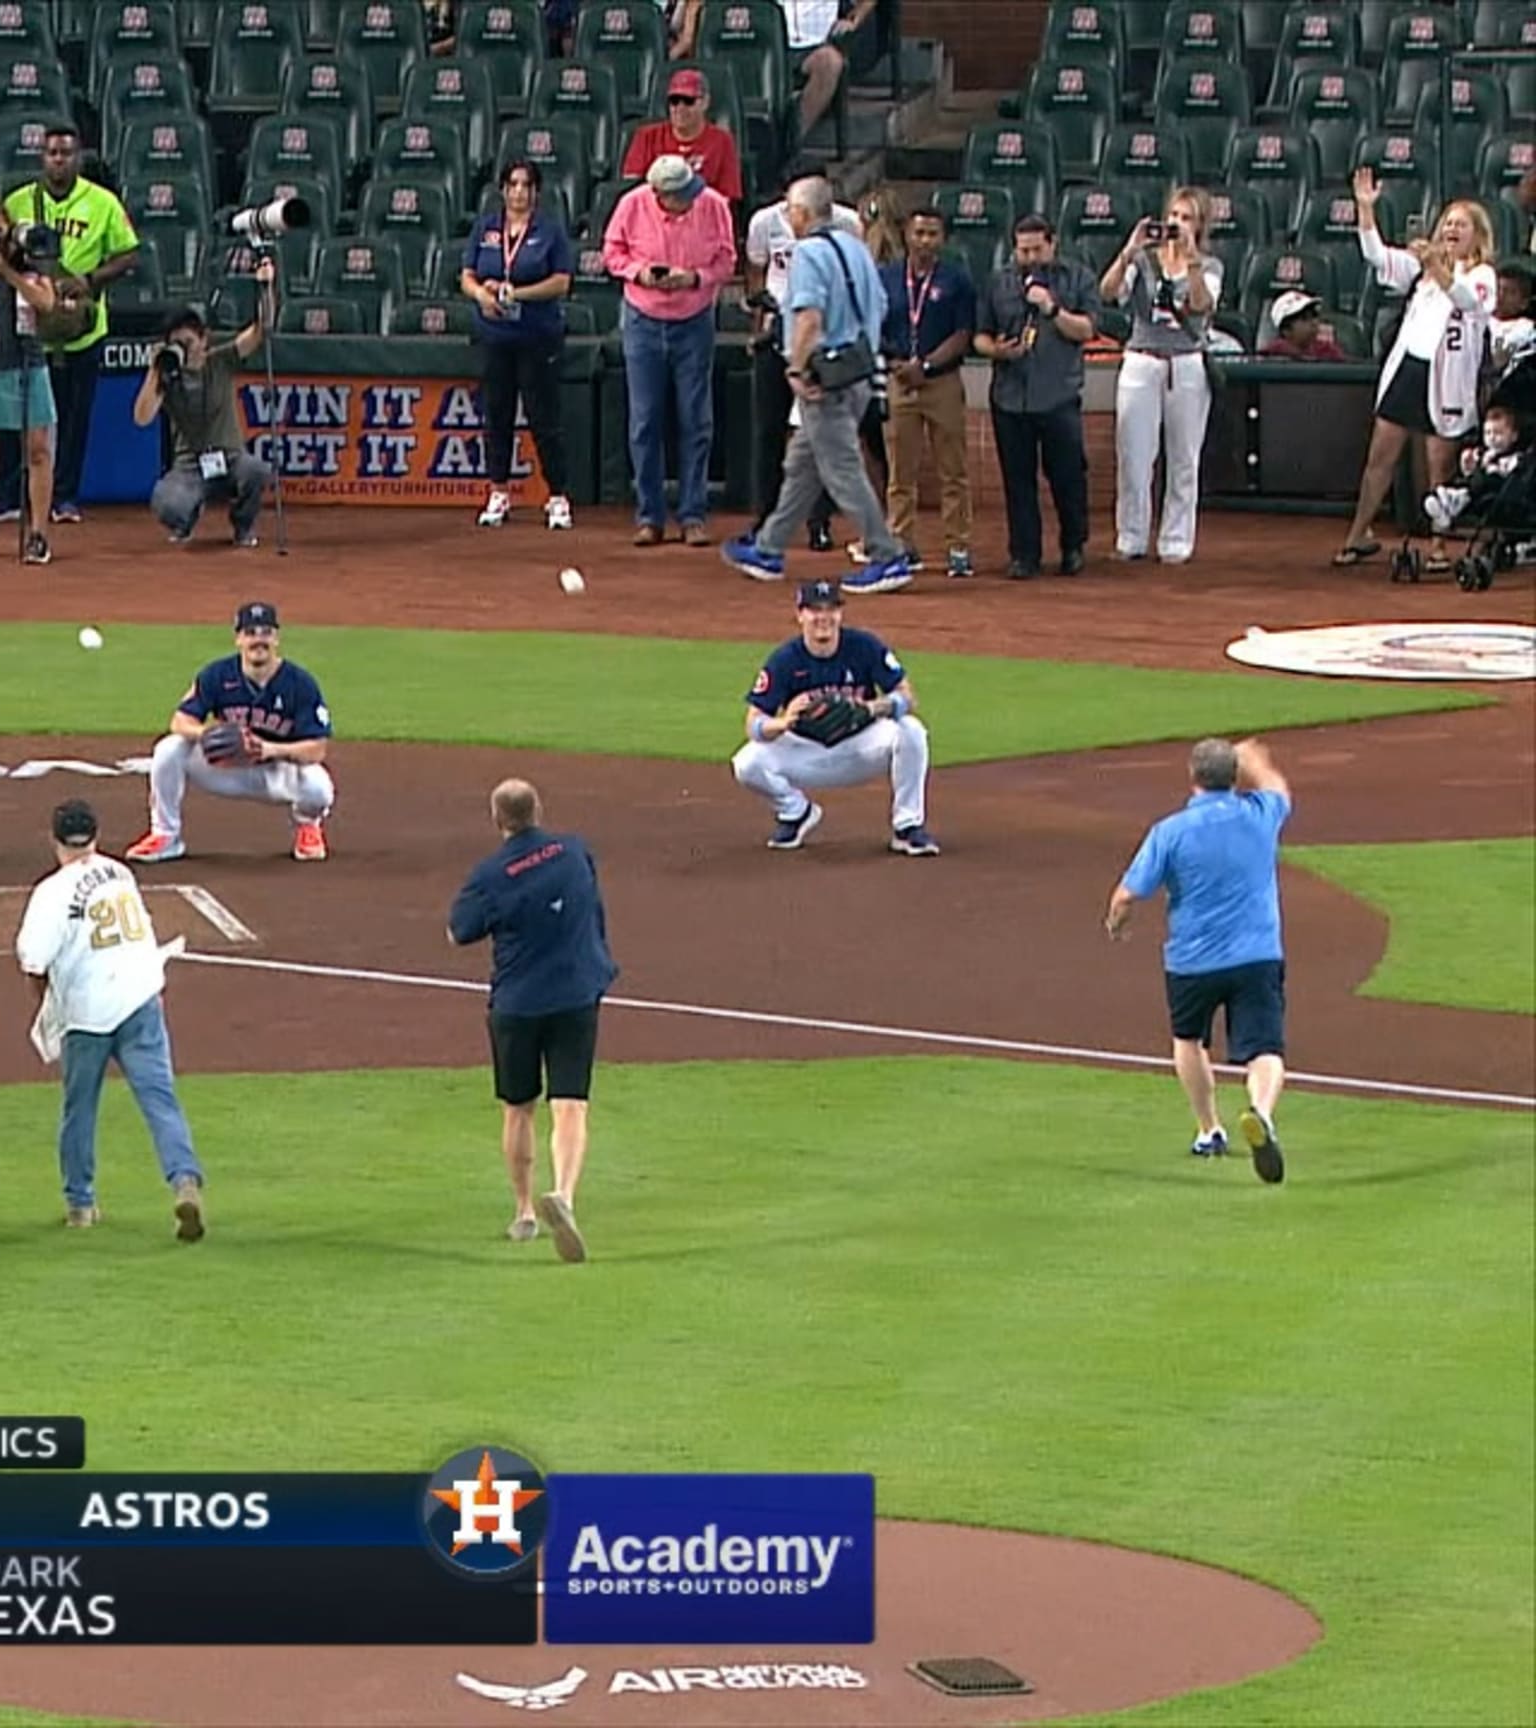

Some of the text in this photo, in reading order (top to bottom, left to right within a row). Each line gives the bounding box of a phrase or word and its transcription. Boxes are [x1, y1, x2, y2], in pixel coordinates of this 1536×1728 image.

[244, 384, 351, 427] WIN
[365, 386, 421, 427] IT
[362, 434, 417, 475] IT
[88, 892, 146, 950] 20
[609, 1667, 724, 1693] AIR
